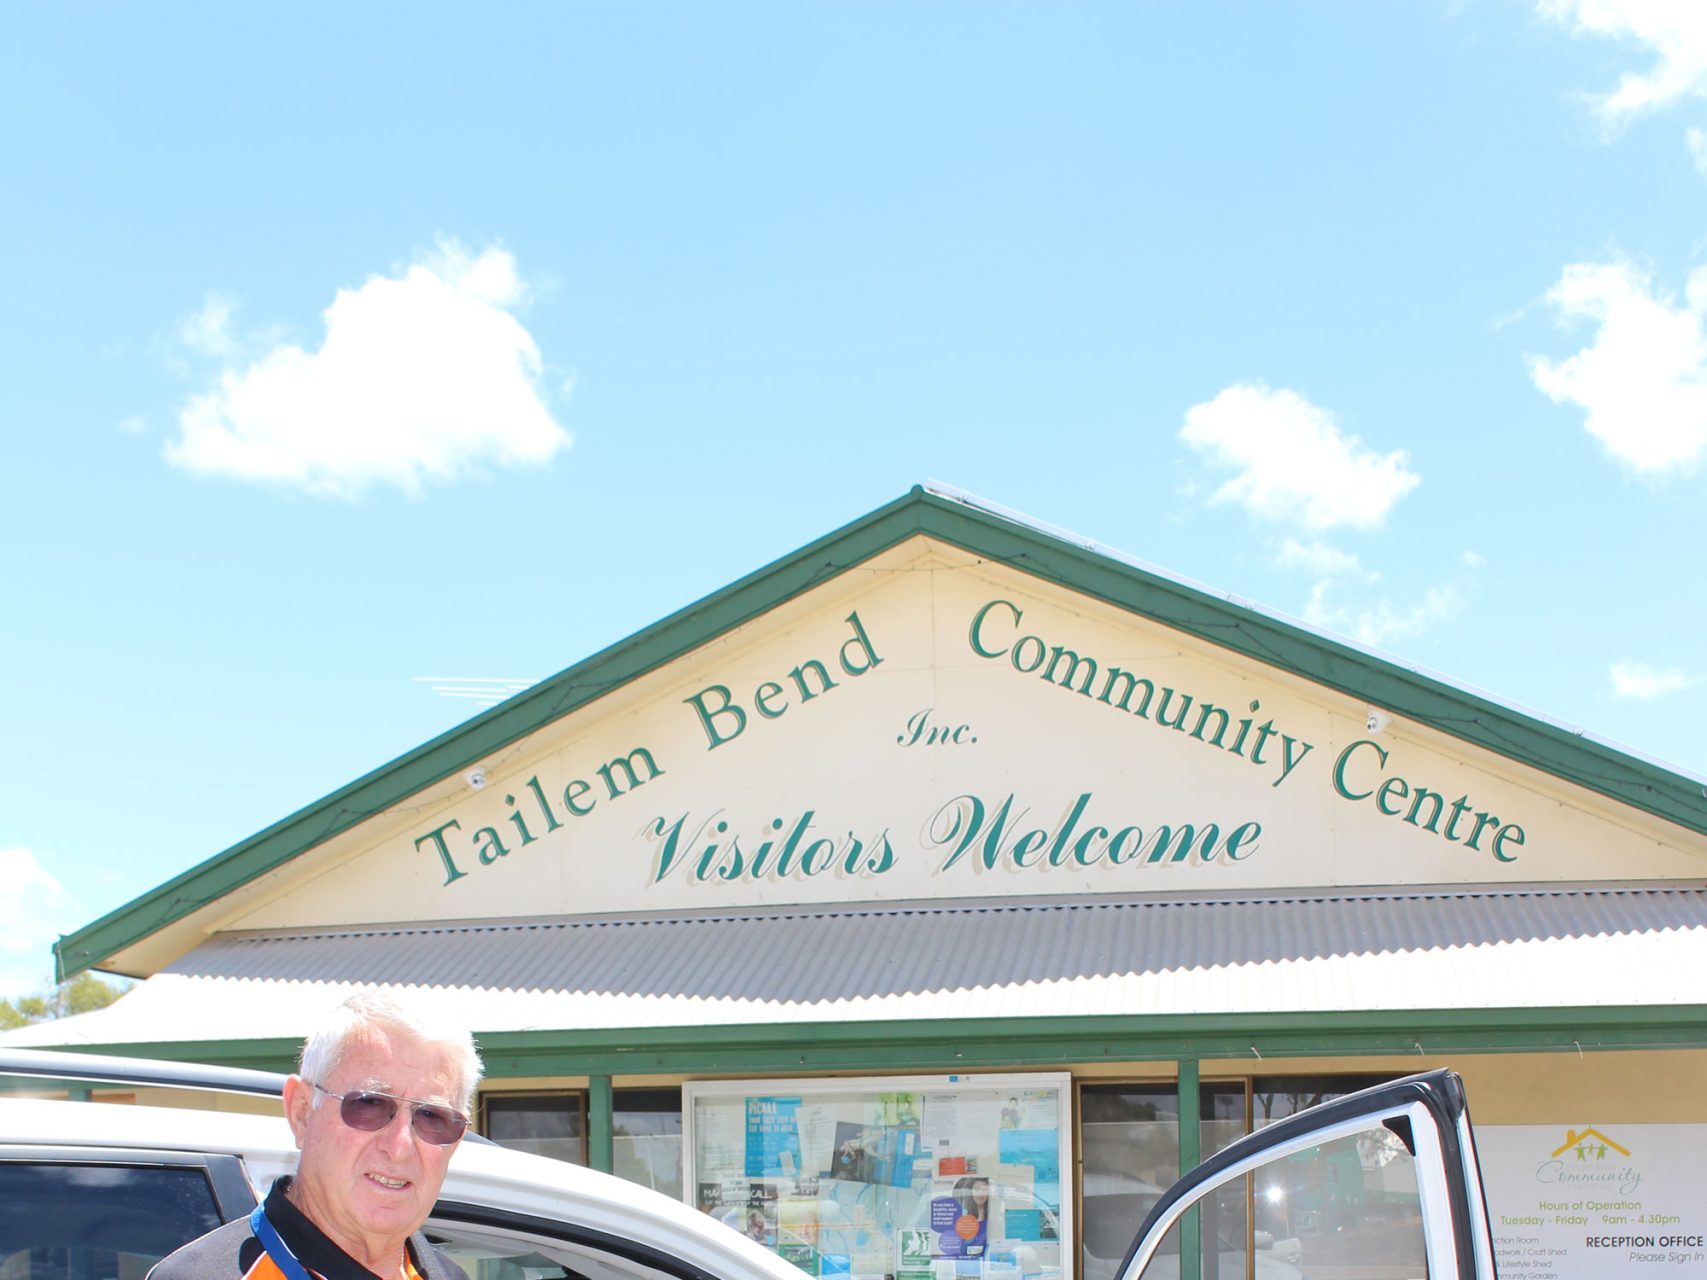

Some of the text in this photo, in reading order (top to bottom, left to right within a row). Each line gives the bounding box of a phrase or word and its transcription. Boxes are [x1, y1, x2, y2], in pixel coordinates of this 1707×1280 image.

[896, 708, 979, 748] Inc.
[413, 599, 1526, 887] Tailem Bend Community Centre
[645, 792, 1264, 885] Visitors Welcome
[1536, 1160, 1643, 1195] Community
[1539, 1200, 1642, 1212] Hours of Operation
[1500, 1215, 1545, 1226] Tuesday
[1555, 1215, 1589, 1226] Friday
[1602, 1215, 1627, 1225] 9am
[1638, 1214, 1681, 1226] 4.30pm
[1586, 1235, 1704, 1248] RECEPTION OFFICE
[1527, 1248, 1546, 1256] Craft
[1547, 1248, 1567, 1256] Shed
[1629, 1251, 1704, 1265] Please Sign In
[1502, 1260, 1531, 1269] Lifestyle
[1533, 1260, 1552, 1268] Shed
[1528, 1272, 1558, 1280] Garden
